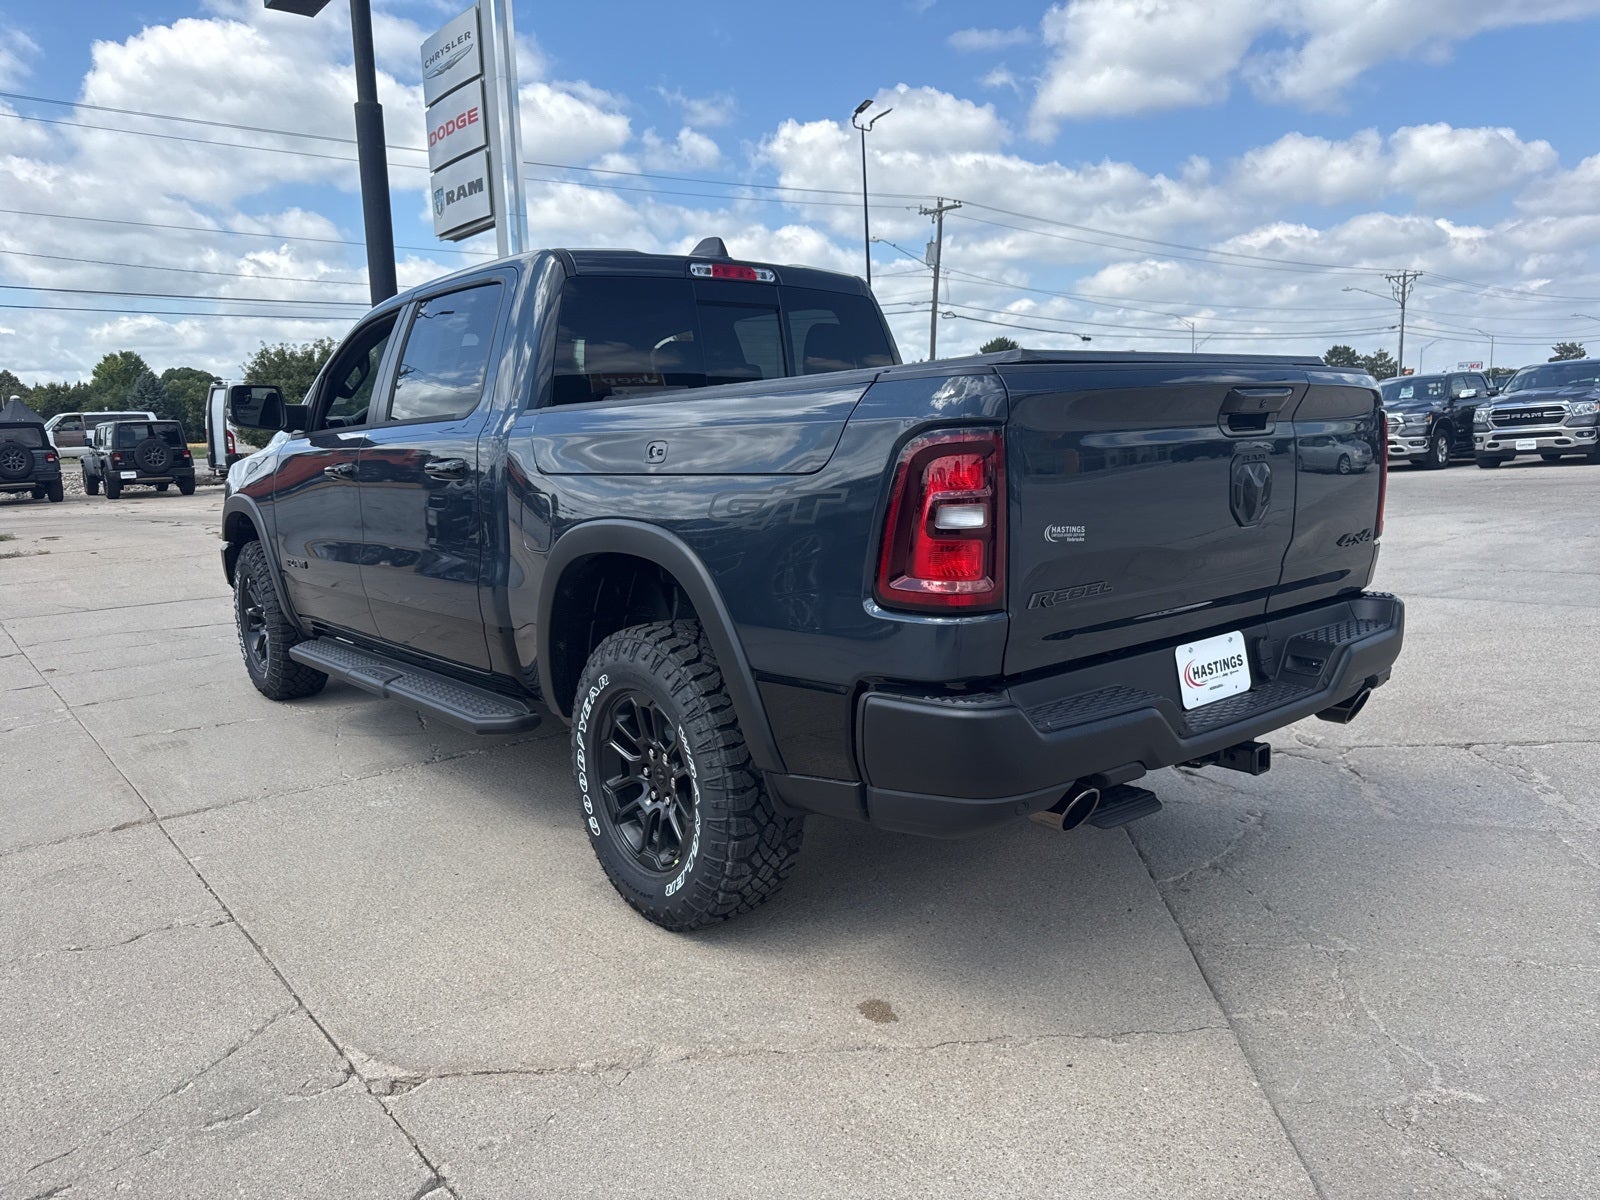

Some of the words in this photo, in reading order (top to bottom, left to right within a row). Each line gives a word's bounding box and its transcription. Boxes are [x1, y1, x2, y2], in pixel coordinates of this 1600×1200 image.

[424, 31, 471, 69] CHRYSLER
[429, 107, 479, 147] DODGE
[446, 178, 483, 206] RAM
[1051, 525, 1086, 534] HASTINGS
[1026, 581, 1114, 610] REBEL
[1192, 654, 1244, 680] HASTINGS
[577, 674, 609, 836] GOODYEAR
